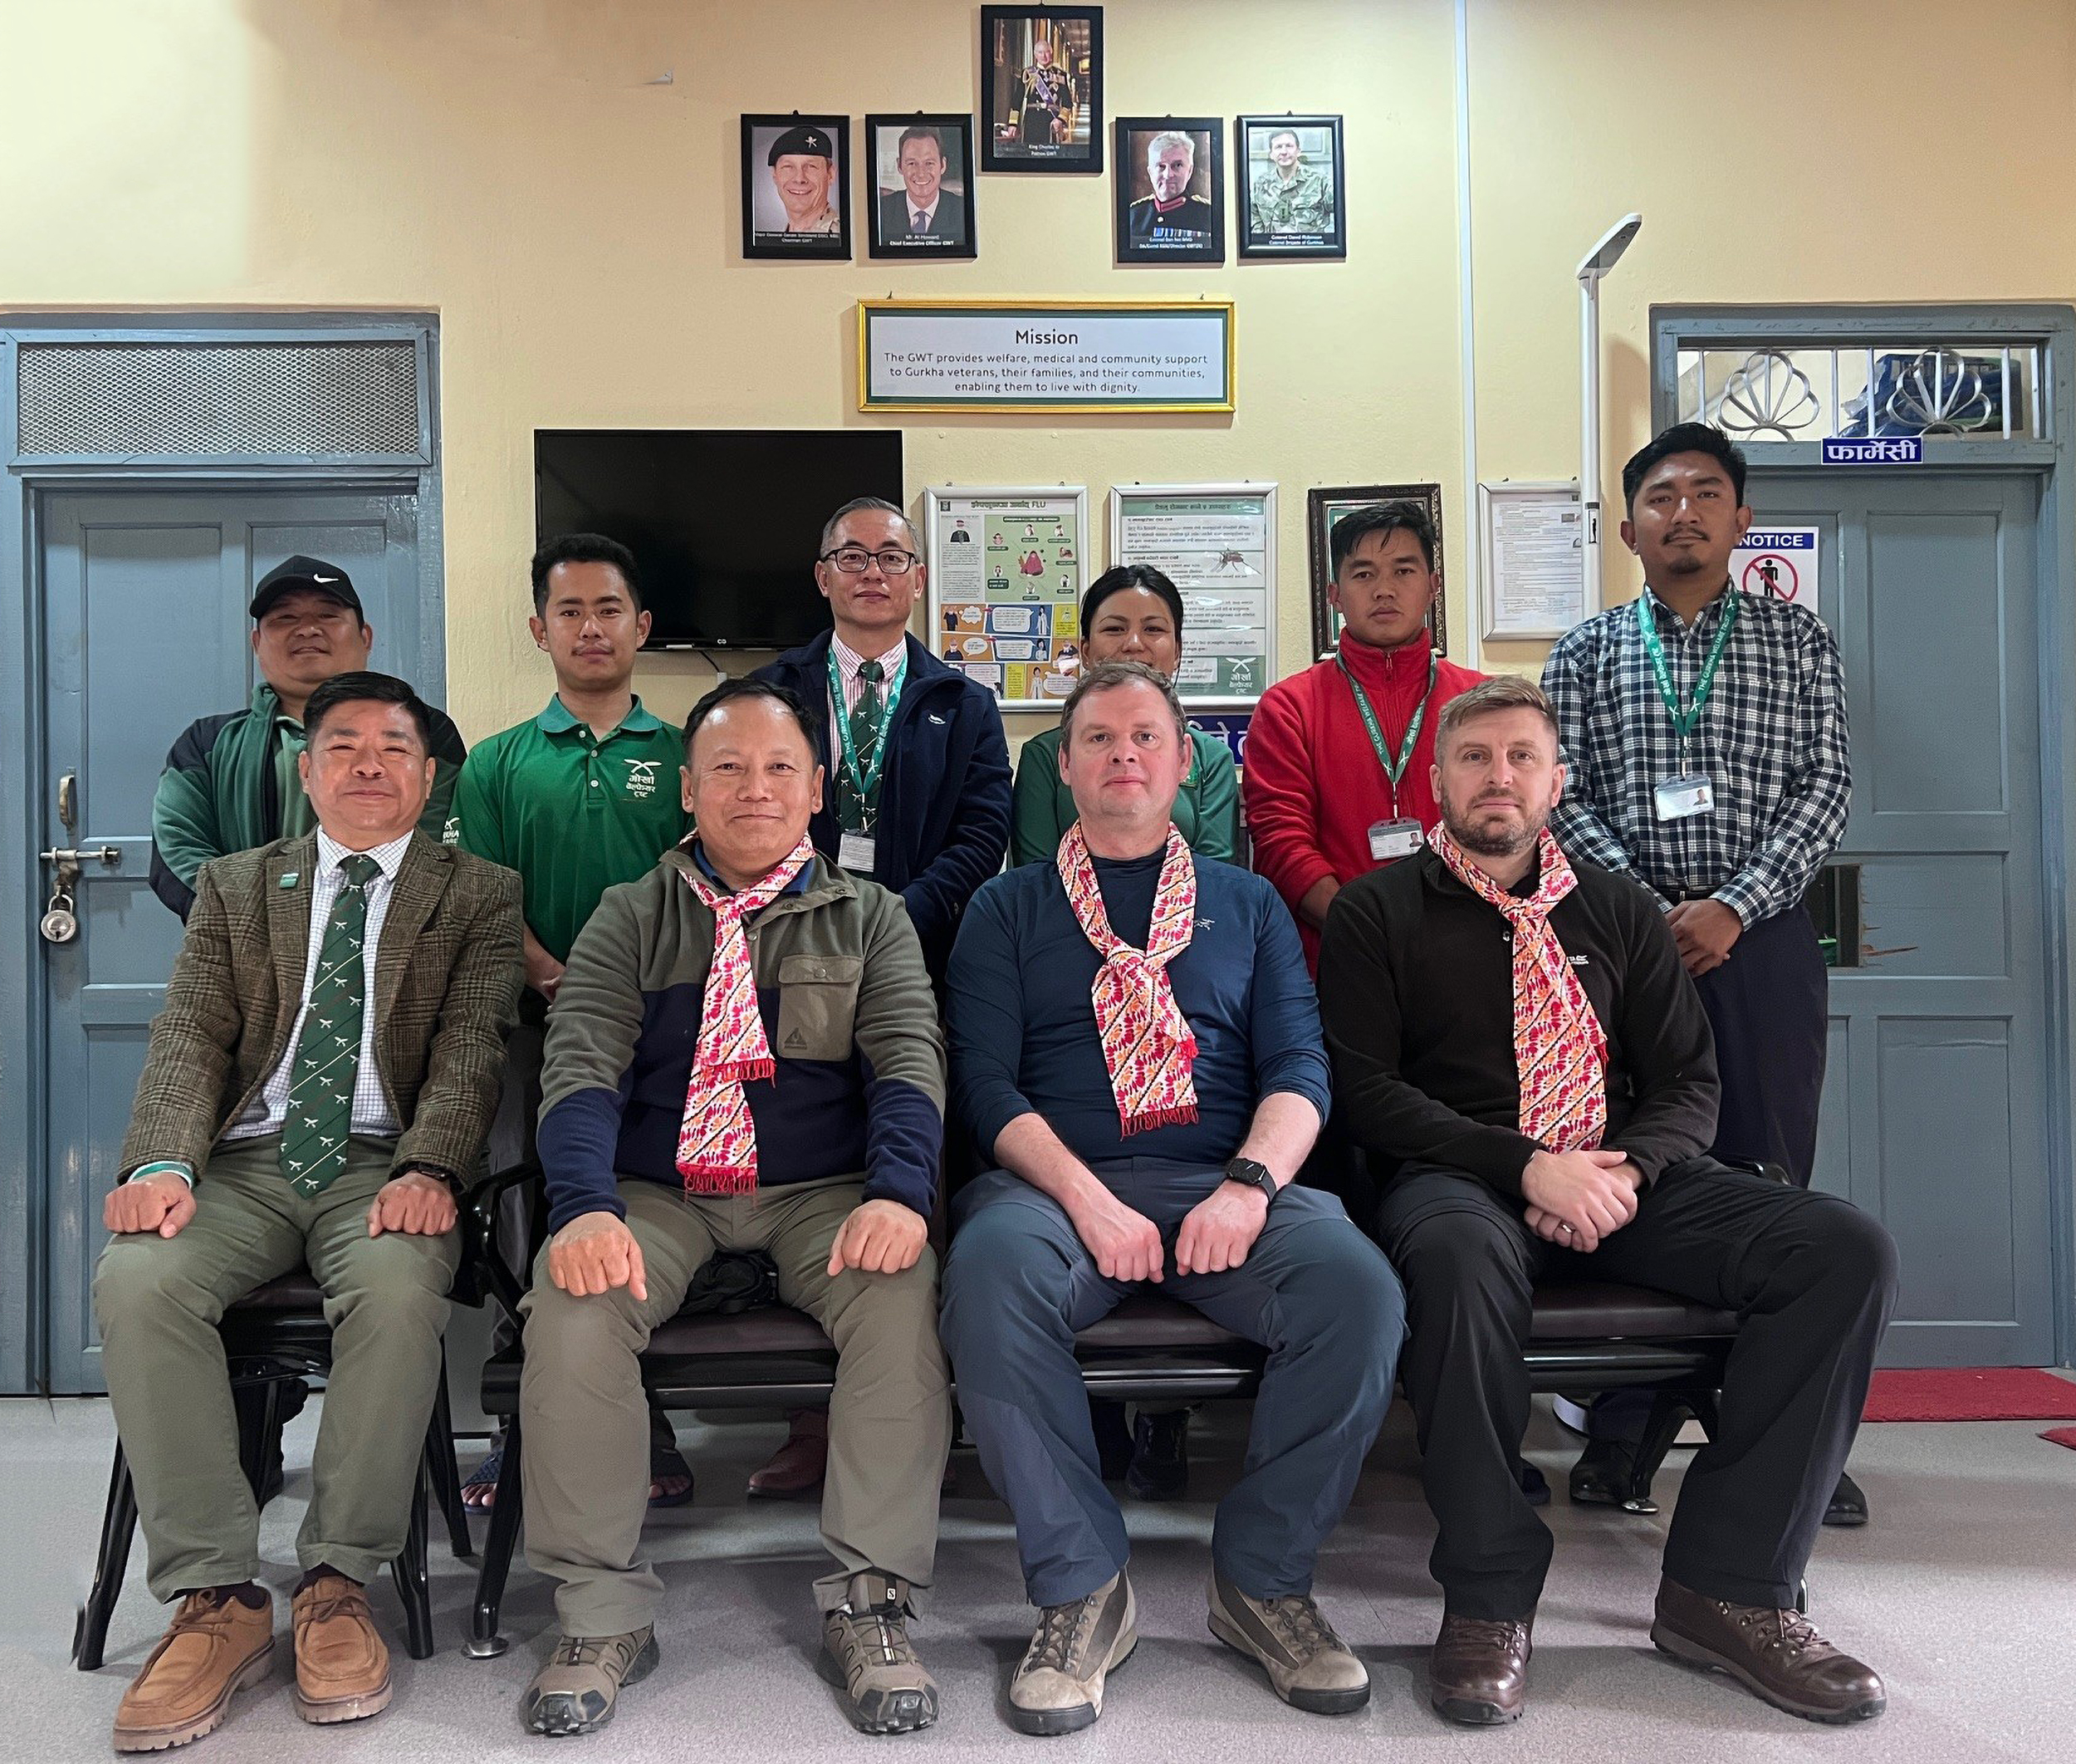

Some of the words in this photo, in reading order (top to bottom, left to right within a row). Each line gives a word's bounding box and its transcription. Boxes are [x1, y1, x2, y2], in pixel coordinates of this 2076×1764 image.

[1016, 329, 1079, 345] Mission
[884, 352, 904, 362] The
[908, 352, 933, 362] GWT
[937, 352, 982, 364] provides
[987, 353, 1030, 364] welfare,
[1034, 353, 1075, 363] medical
[1079, 354, 1097, 364] and
[1101, 355, 1161, 365] community
[1165, 355, 1207, 365] support
[890, 367, 902, 376] to
[905, 366, 944, 376] Gurkha
[947, 368, 997, 379] veterans,
[1001, 367, 1027, 377] their
[1031, 367, 1075, 378] families,
[1080, 368, 1099, 377] and
[1103, 368, 1129, 377] their
[1132, 368, 1205, 379] communities,
[955, 381, 1001, 394] enabling
[1004, 382, 1031, 391] them
[1036, 383, 1047, 391] to
[1050, 382, 1070, 391] live
[1073, 382, 1097, 391] with
[1100, 382, 1140, 394] dignity.
[1739, 534, 1804, 547] NOTICE
[1698, 678, 1707, 691] THE
[1376, 741, 1385, 754] THE
